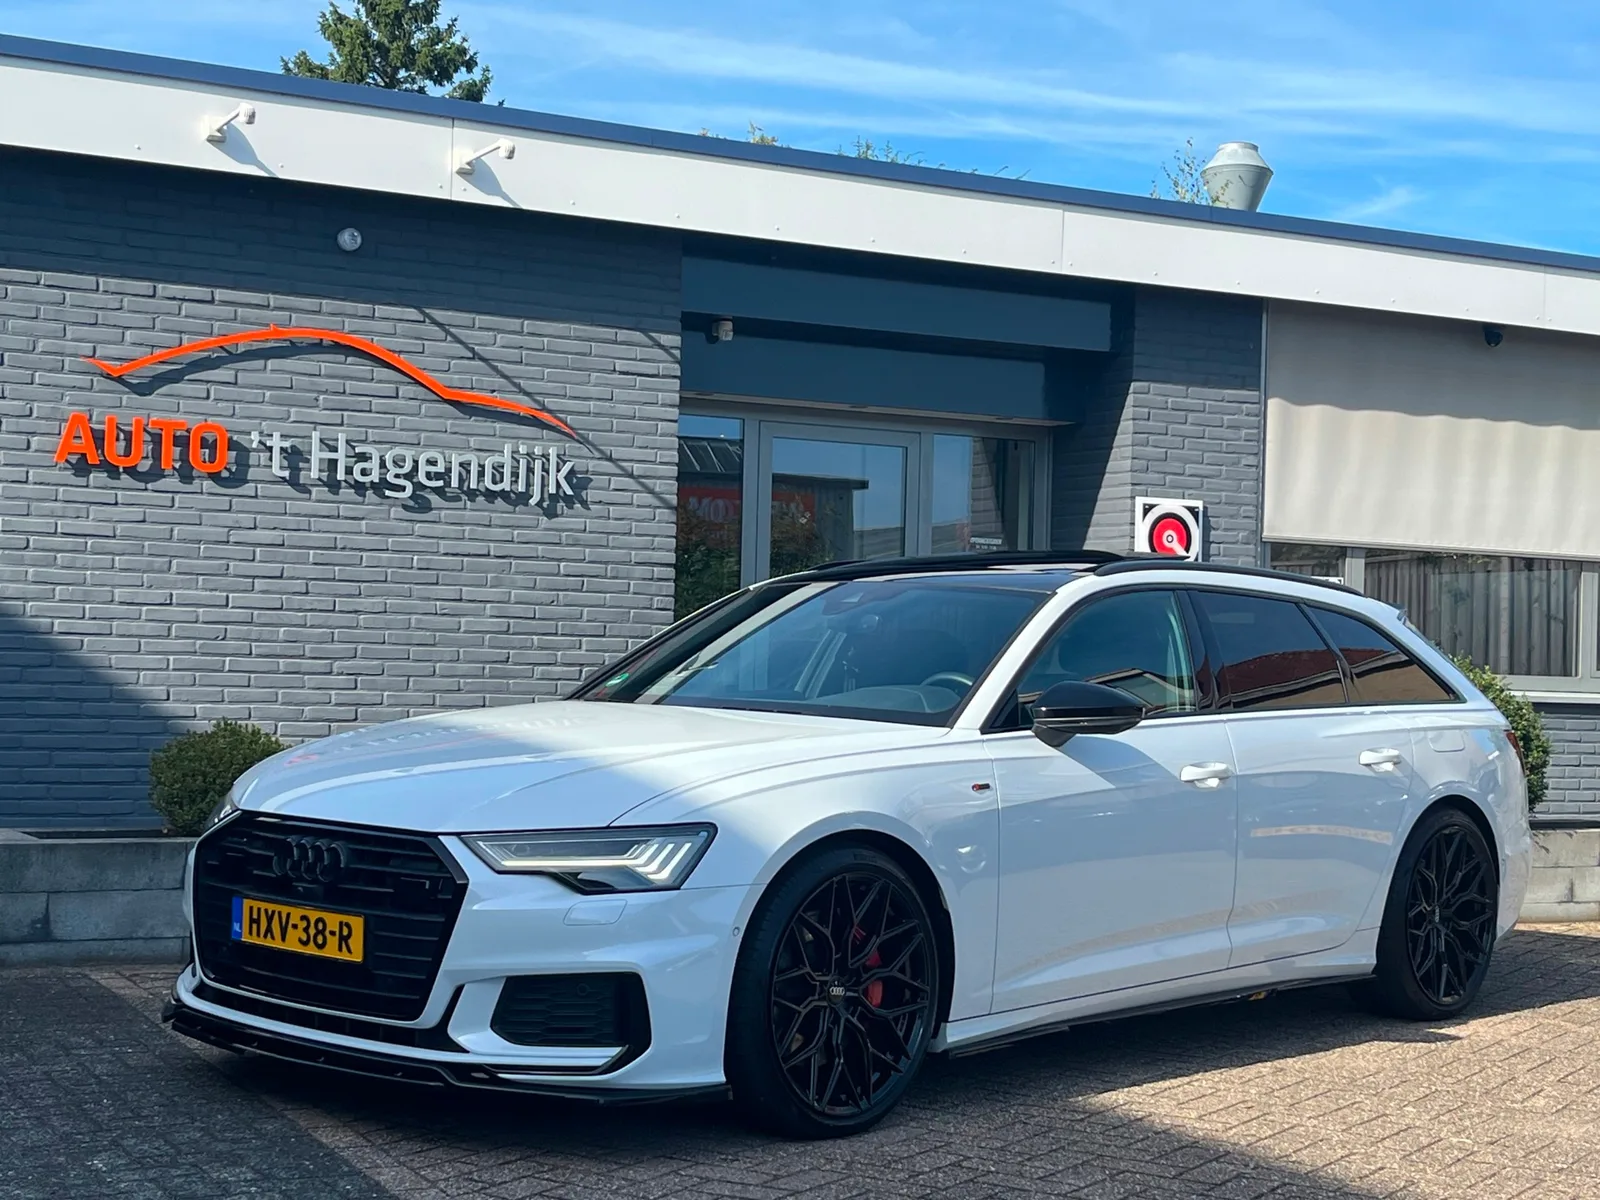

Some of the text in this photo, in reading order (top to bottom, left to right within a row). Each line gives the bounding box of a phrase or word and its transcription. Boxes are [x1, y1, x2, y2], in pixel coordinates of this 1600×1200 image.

[54, 412, 229, 473] AUTO
[310, 431, 575, 506] Hagendijk
[248, 905, 353, 955] HXV-38-R
